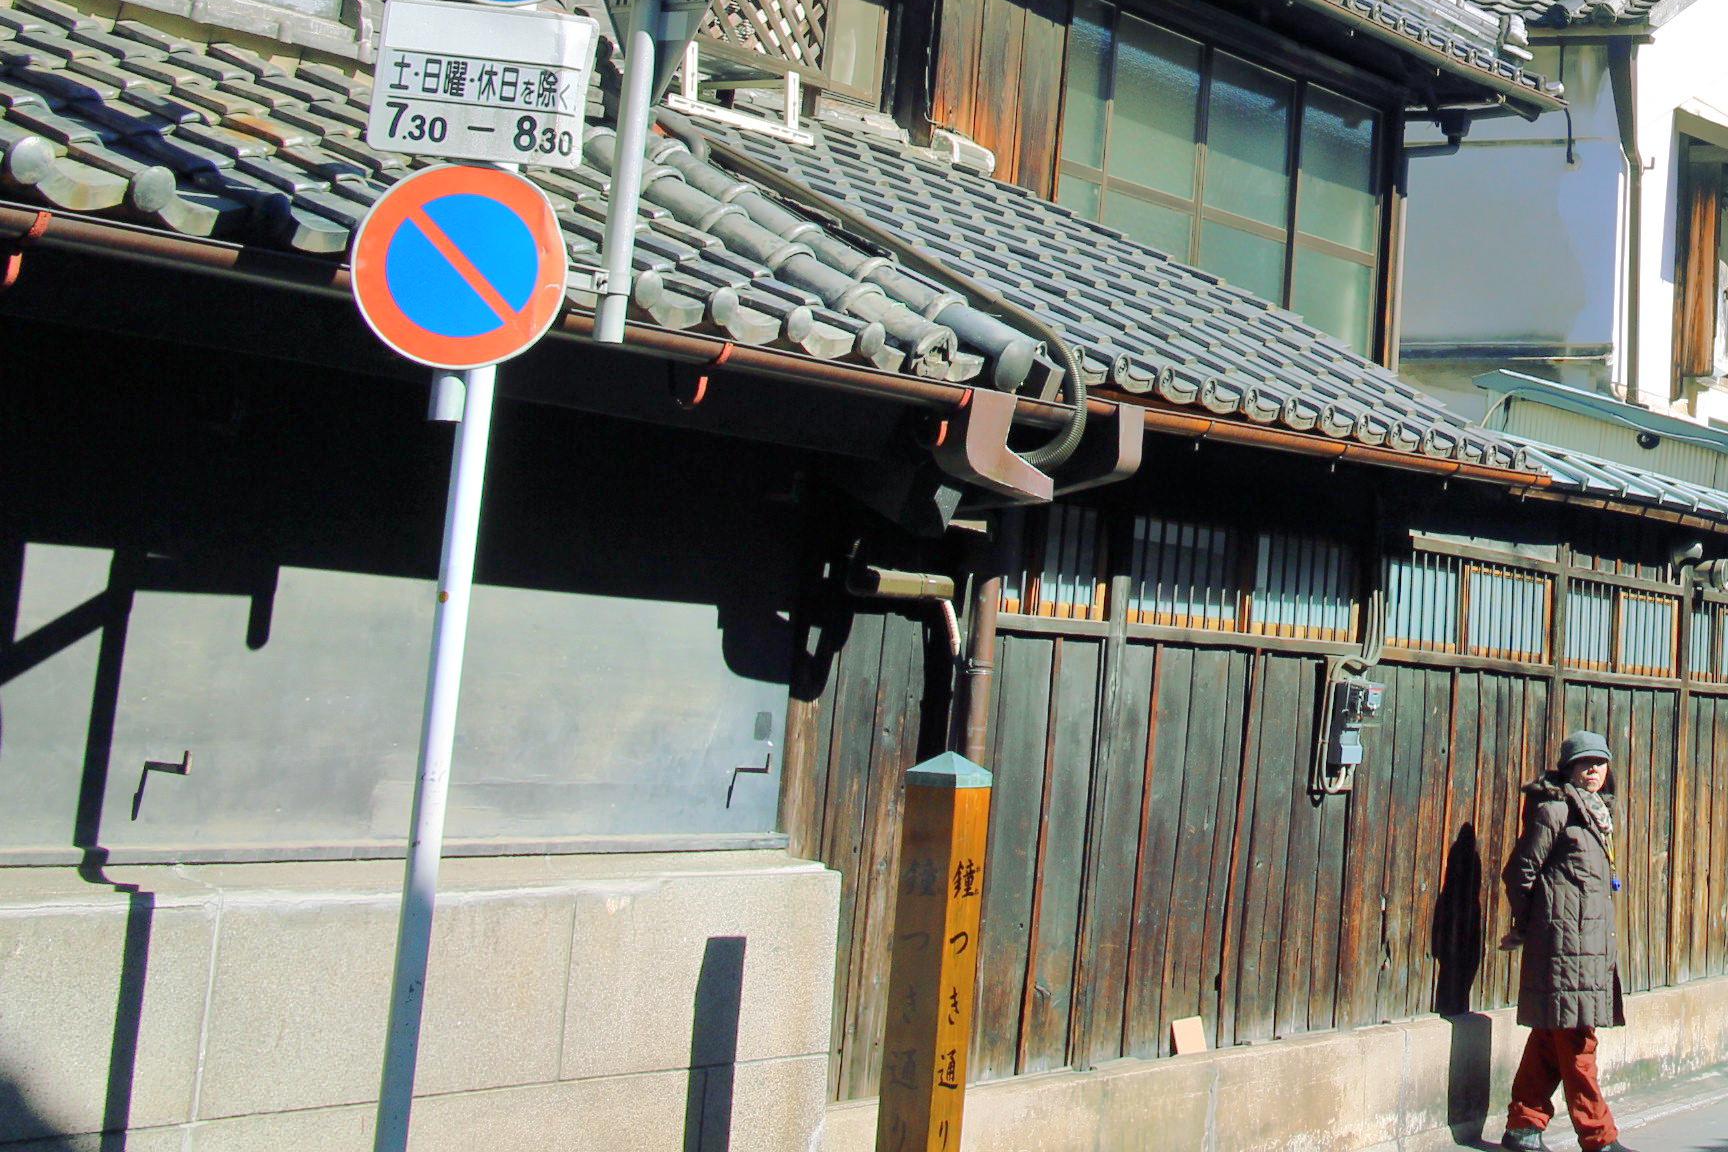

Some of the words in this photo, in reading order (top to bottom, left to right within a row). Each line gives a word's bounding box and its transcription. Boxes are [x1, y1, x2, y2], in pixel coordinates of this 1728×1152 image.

[389, 54, 571, 111] 土・日曜・休日を除く
[385, 101, 448, 143] 7.30
[513, 115, 574, 157] 8.30
[938, 859, 976, 1151] 鐘つき通り
